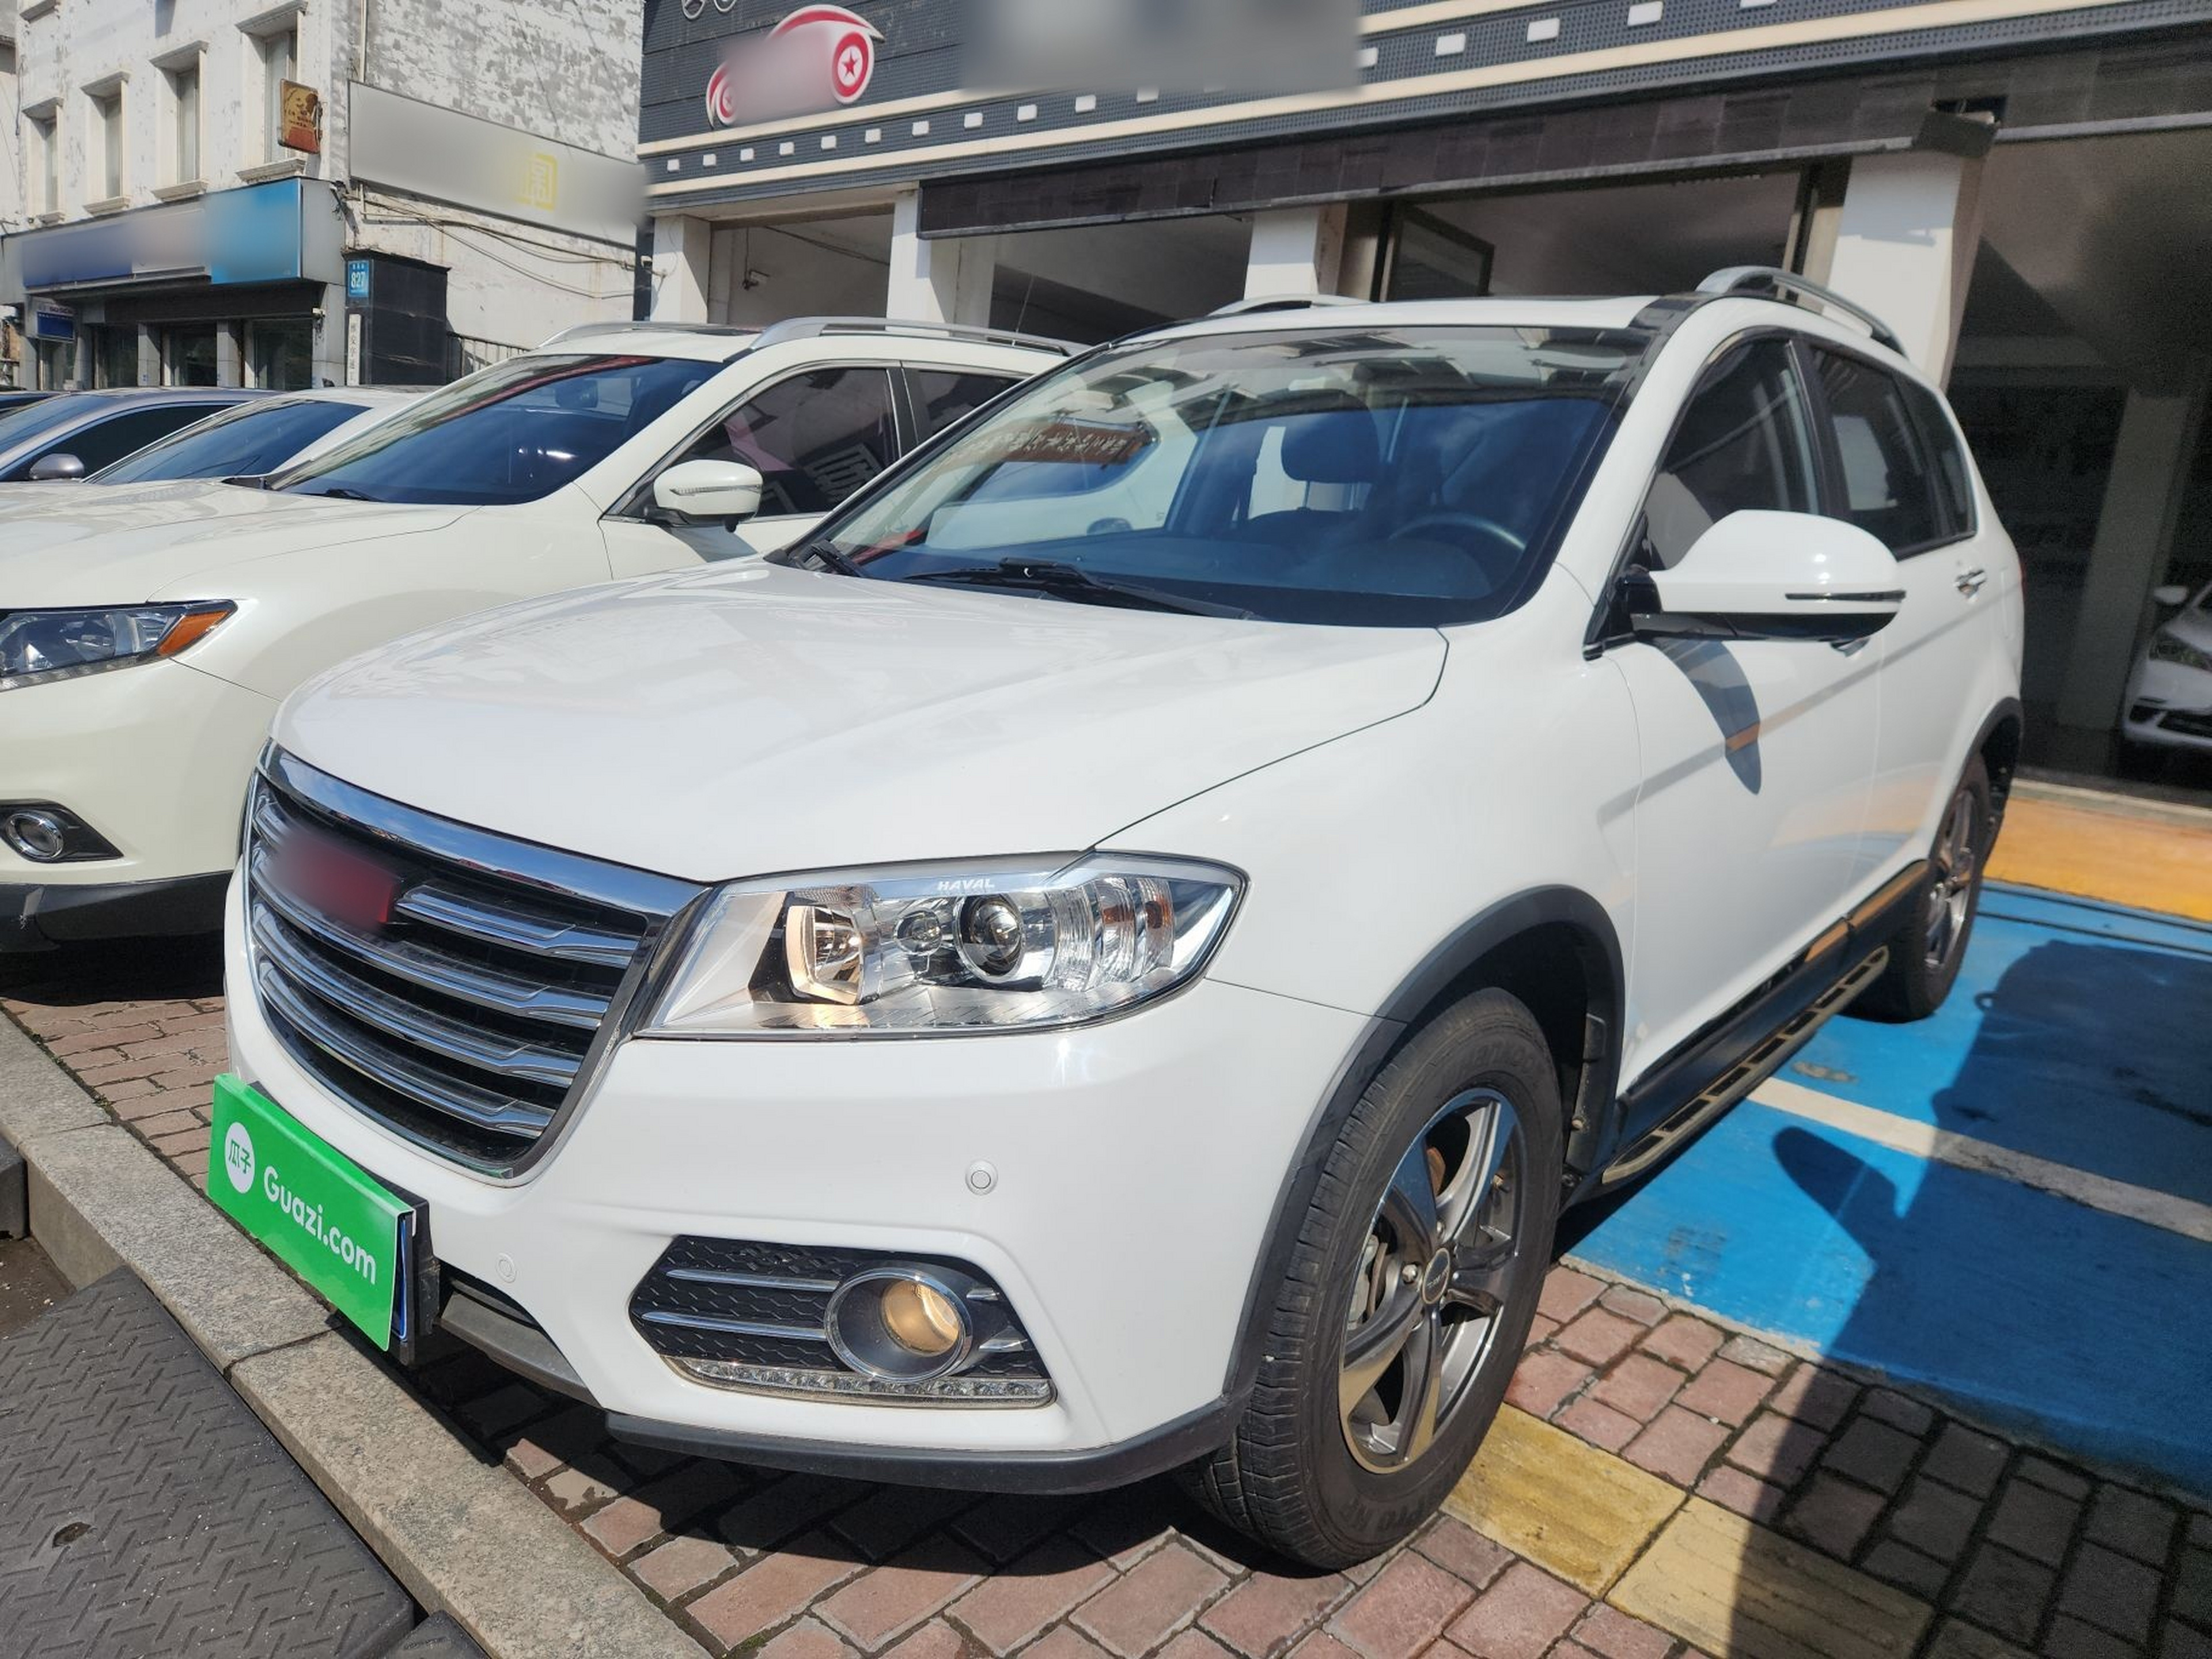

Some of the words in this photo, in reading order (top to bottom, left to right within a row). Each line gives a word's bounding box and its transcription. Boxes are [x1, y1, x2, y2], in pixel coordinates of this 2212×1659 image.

[351, 271, 366, 289] 827
[937, 878, 995, 891] HAVAL
[229, 1140, 251, 1175] 瓜子
[264, 1165, 376, 1285] Guazi.com
